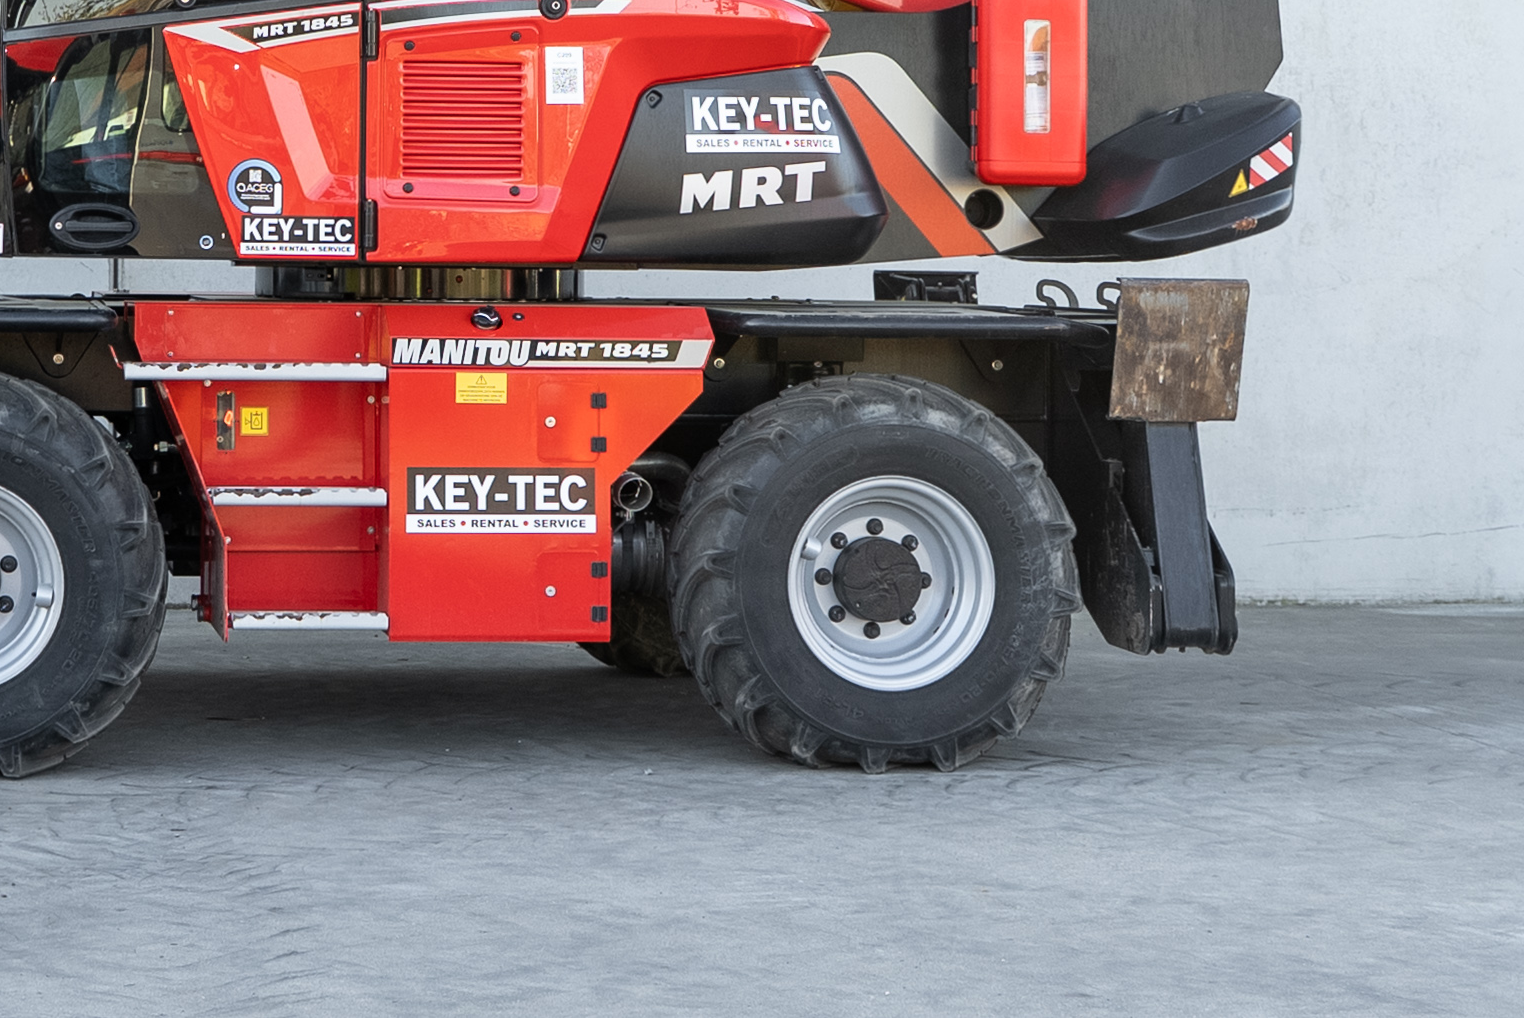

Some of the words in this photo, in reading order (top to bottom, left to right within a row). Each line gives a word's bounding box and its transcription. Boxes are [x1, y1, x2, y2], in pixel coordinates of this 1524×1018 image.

[253, 21, 297, 39] MRT
[300, 13, 354, 32] 1845
[691, 96, 831, 132] KEY-TEC
[696, 139, 730, 148] SALES
[742, 139, 782, 148] RENTAL
[794, 139, 834, 148] SERVICE
[679, 161, 826, 214] MRT
[243, 217, 353, 242] KEY-TEC
[318, 245, 351, 253] SERVICE
[393, 338, 531, 366] MANITOU
[535, 342, 595, 358] MRT
[599, 342, 669, 359] 1845
[415, 474, 588, 512] KEY-TEC
[417, 519, 456, 528] SALES
[470, 519, 519, 528] RENTAL
[533, 519, 587, 528] SERVICE
